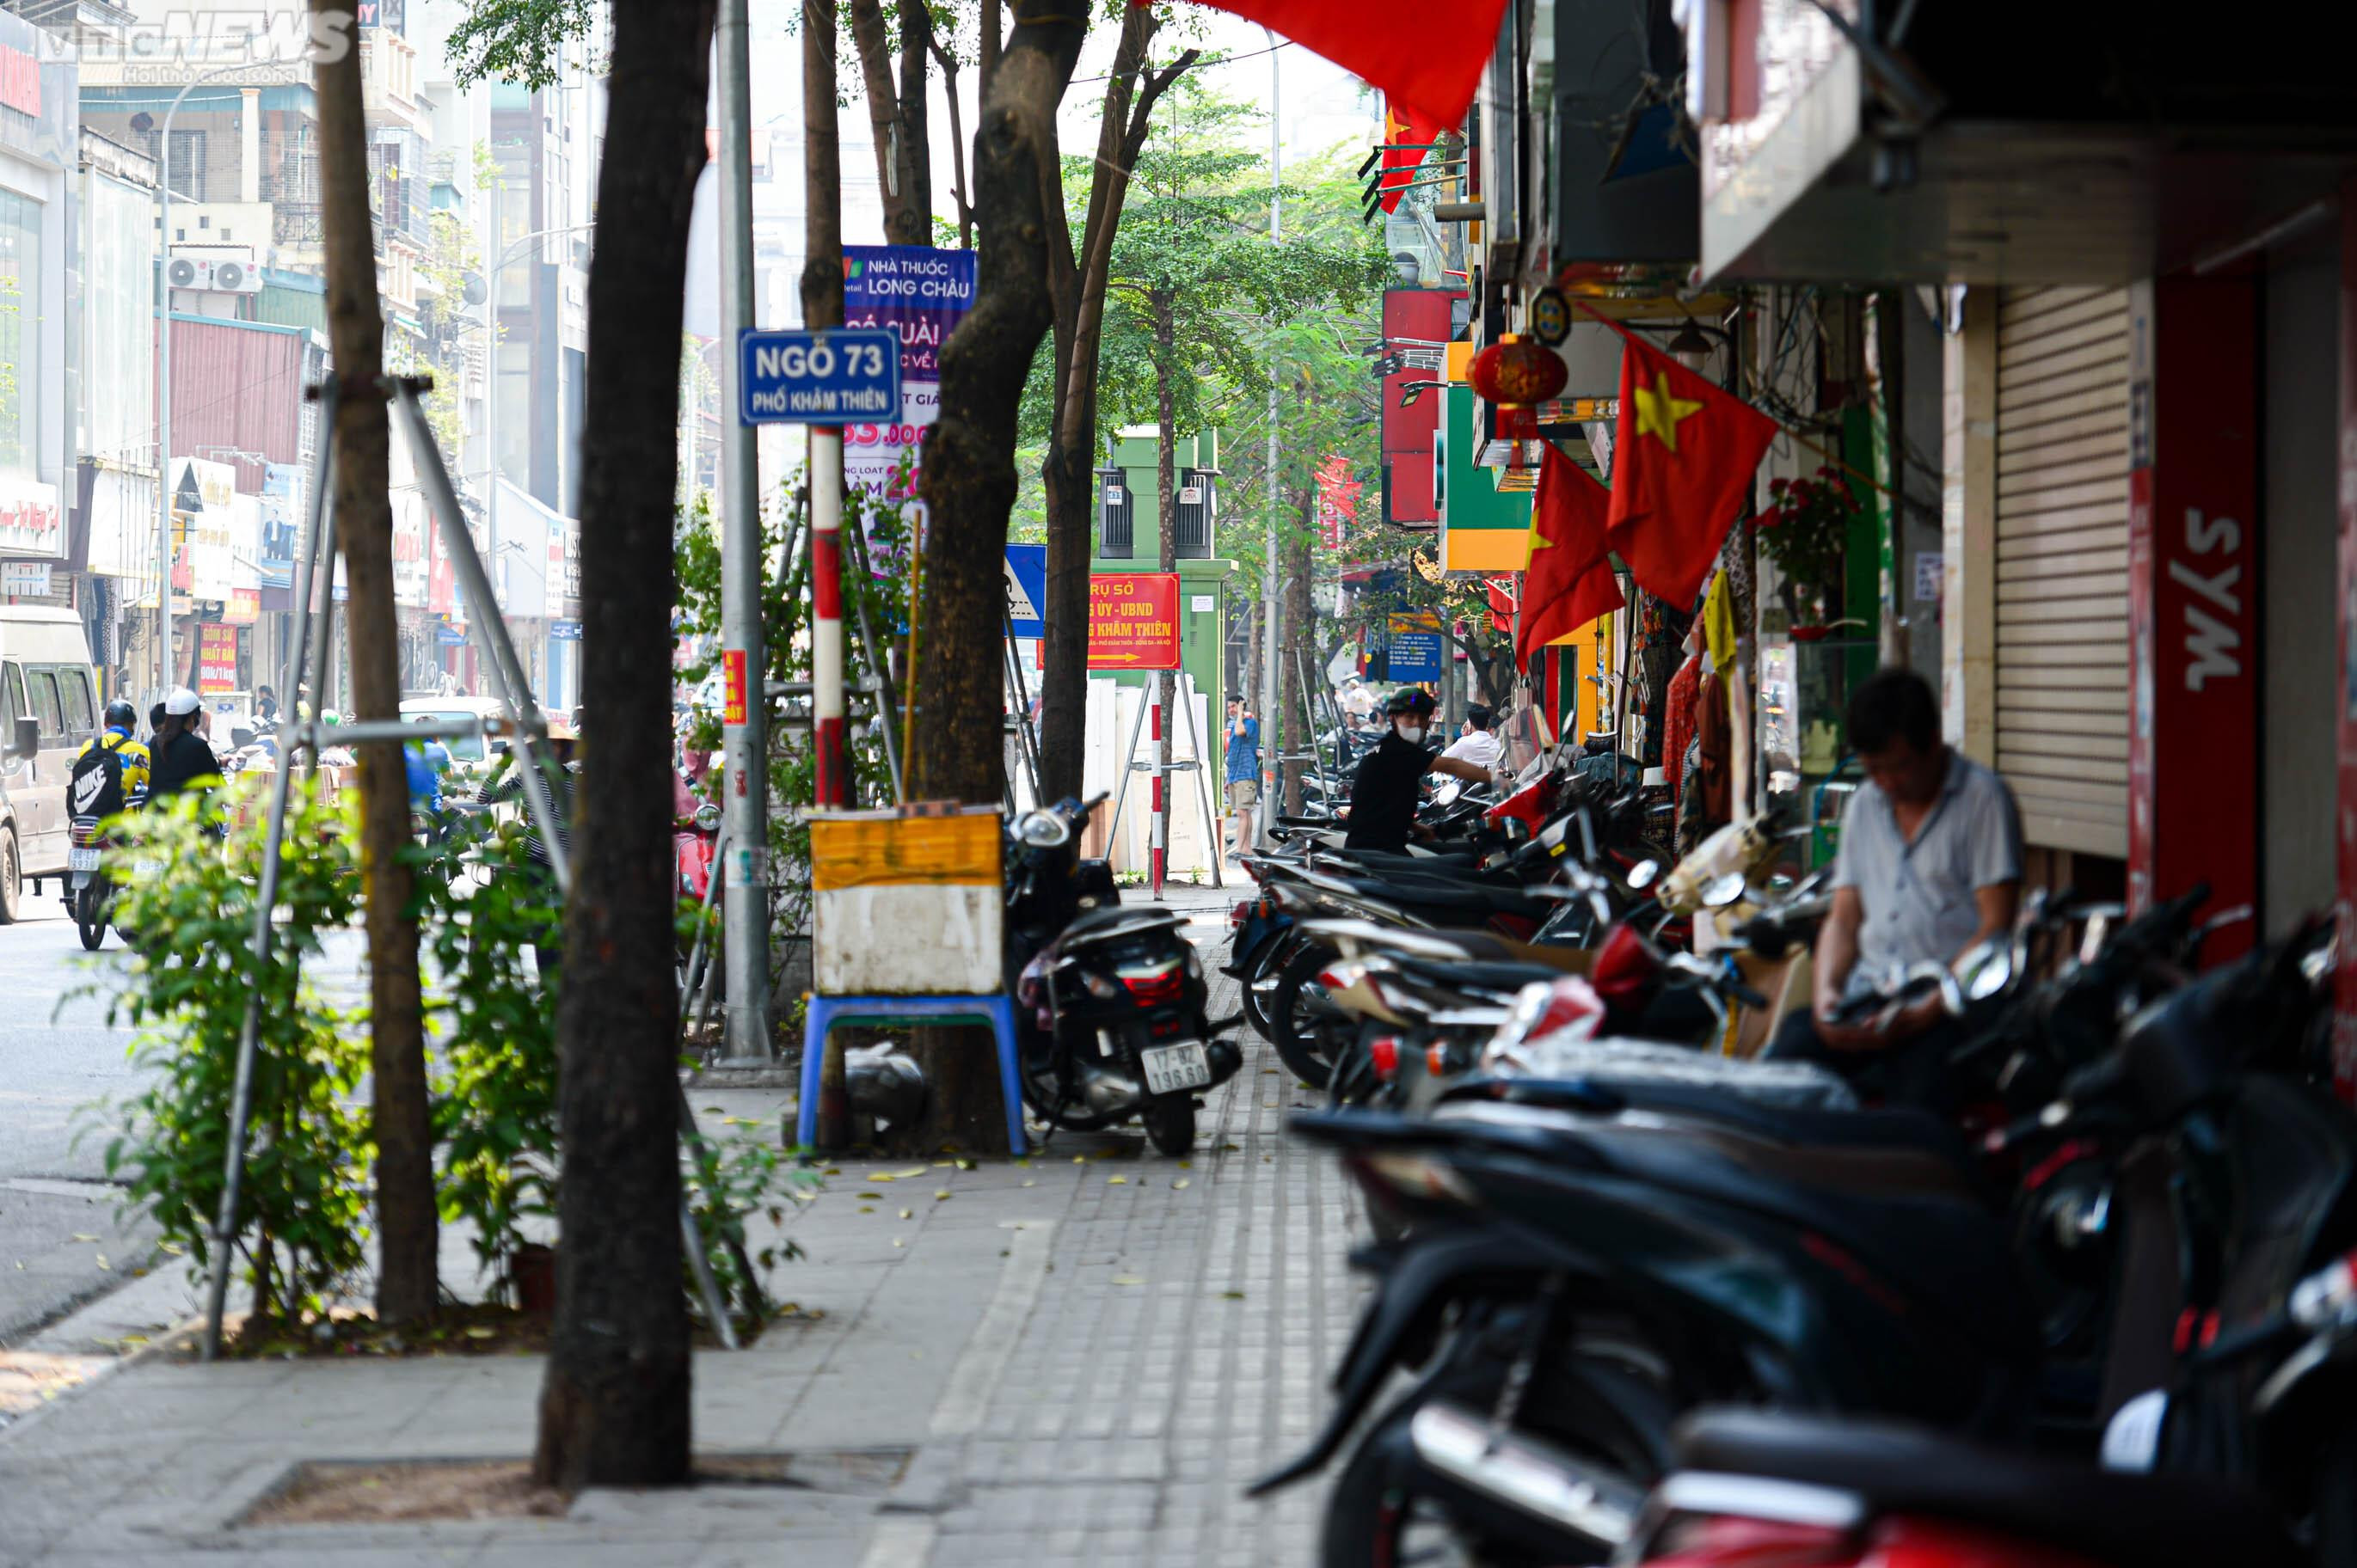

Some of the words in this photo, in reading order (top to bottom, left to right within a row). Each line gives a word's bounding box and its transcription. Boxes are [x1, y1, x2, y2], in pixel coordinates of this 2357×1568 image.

[869, 257, 898, 274] NHÀ
[901, 258, 948, 275] THUỐC
[868, 279, 917, 296] LONG
[921, 277, 970, 298] CHÂU
[887, 315, 939, 345] UÀ!
[844, 345, 884, 377] 73
[752, 385, 787, 413] PHỐ
[789, 387, 837, 412] KHÂM
[839, 385, 887, 412] THIÊN
[1089, 584, 1110, 597] RỤ
[1114, 580, 1134, 596] SỞ
[2169, 508, 2241, 692] SYM
[1097, 599, 1113, 616] ỦY
[1120, 603, 1153, 616] UBND
[1097, 621, 1132, 637] KHÂM
[1135, 620, 1171, 637] THIÊN
[75, 763, 107, 799] NIKE
